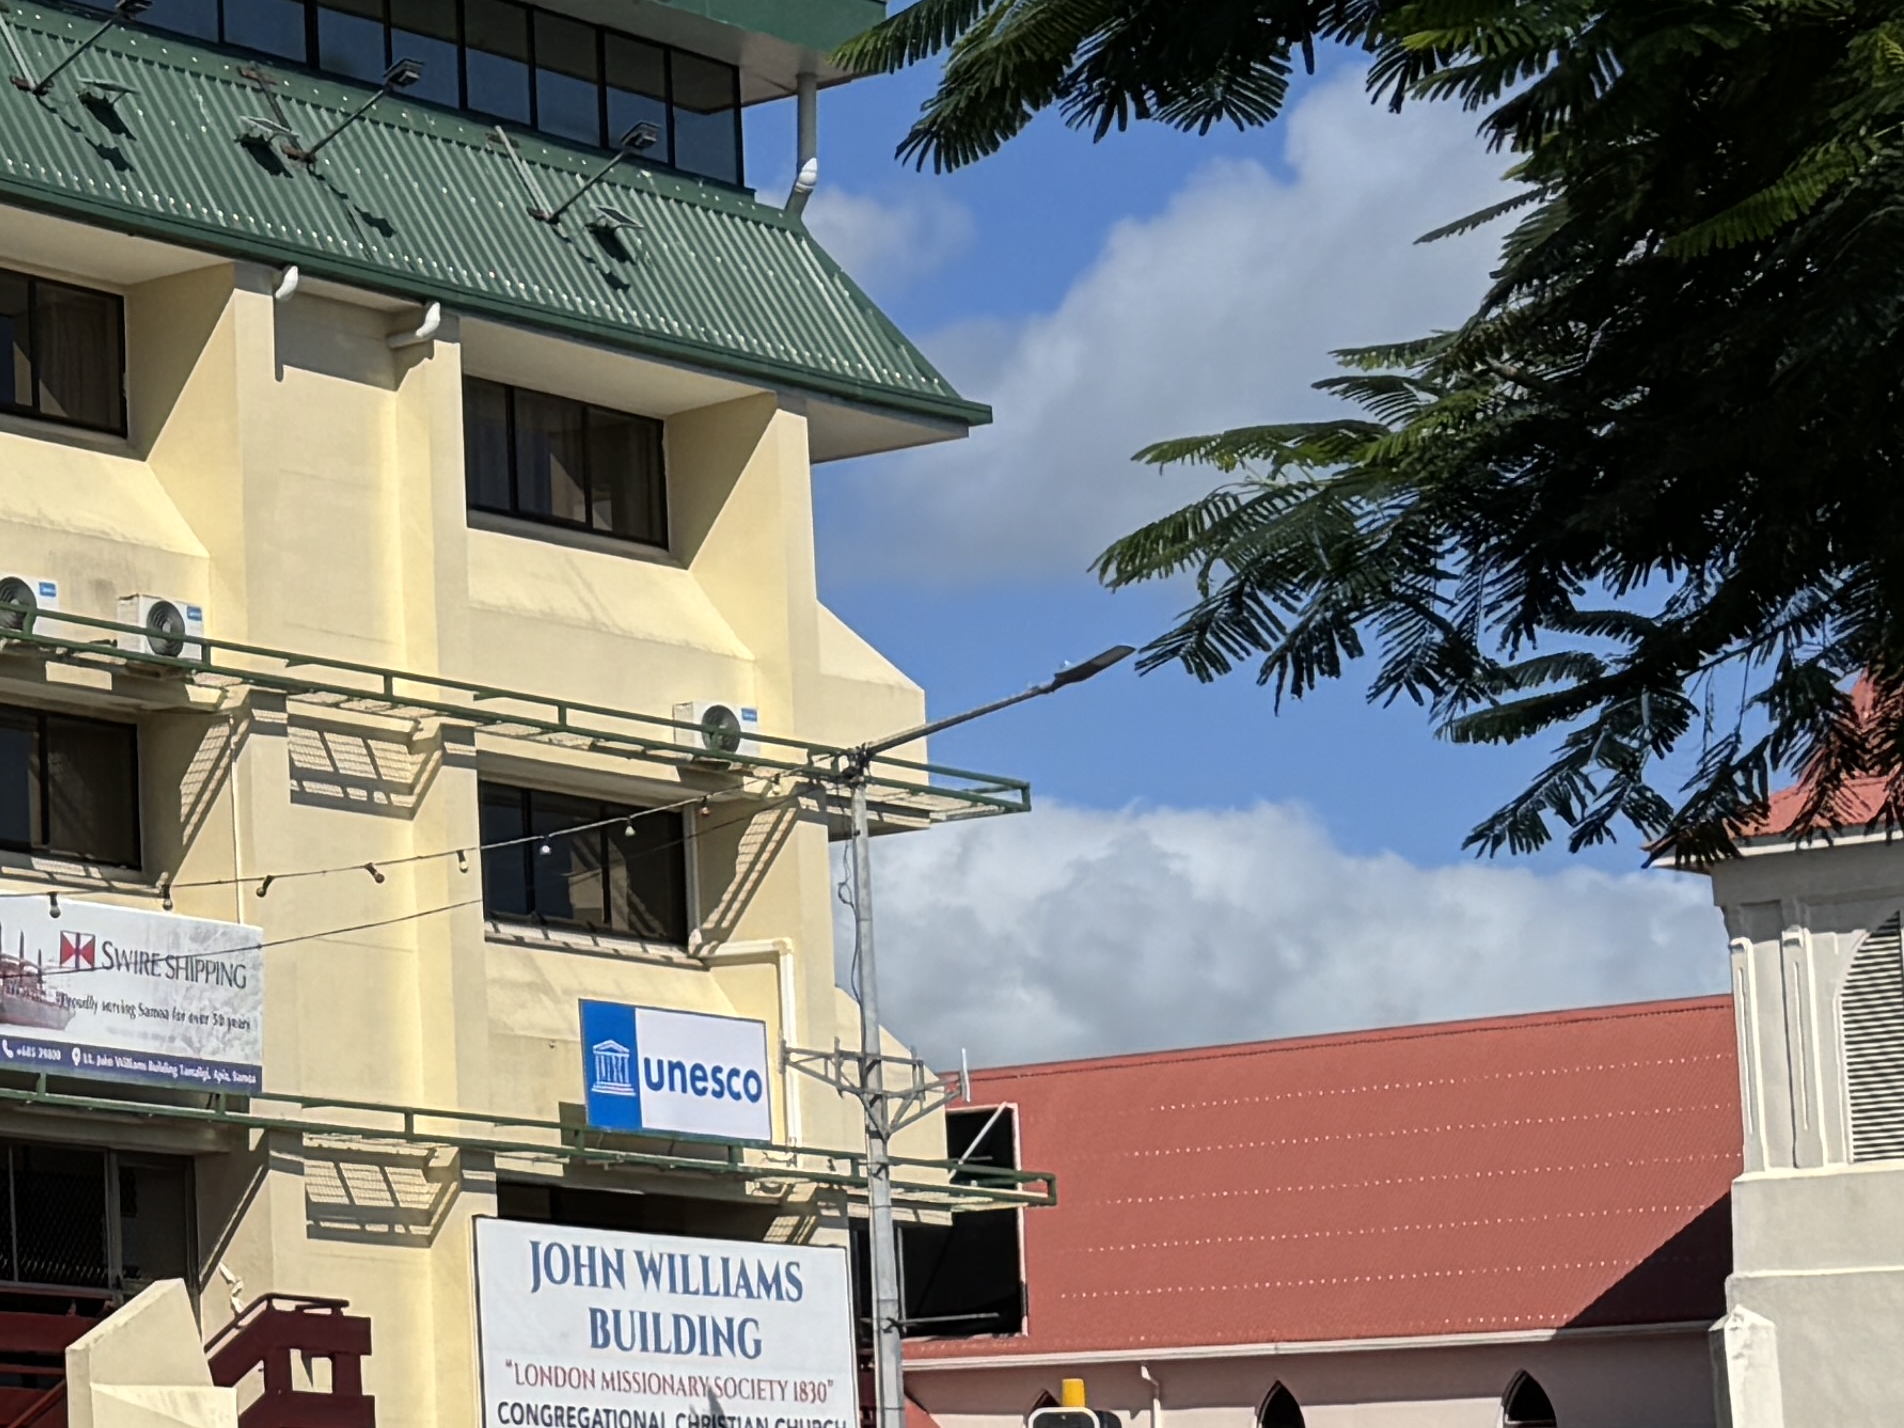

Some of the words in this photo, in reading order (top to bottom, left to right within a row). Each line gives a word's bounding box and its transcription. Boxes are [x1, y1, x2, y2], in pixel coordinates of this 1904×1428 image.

[101, 940, 162, 978] SWIRE
[164, 954, 247, 990] SHIPPING
[138, 1002, 170, 1021] Samoa
[172, 1005, 186, 1023] for
[187, 1011, 210, 1026] over
[644, 1056, 763, 1104] unesco
[528, 1240, 626, 1294] JOHN
[634, 1248, 804, 1303] WILLIAMS
[589, 1307, 763, 1360] BUILDING
[601, 1369, 710, 1399] MISSIONARY
[713, 1376, 788, 1402] SOCIETY
